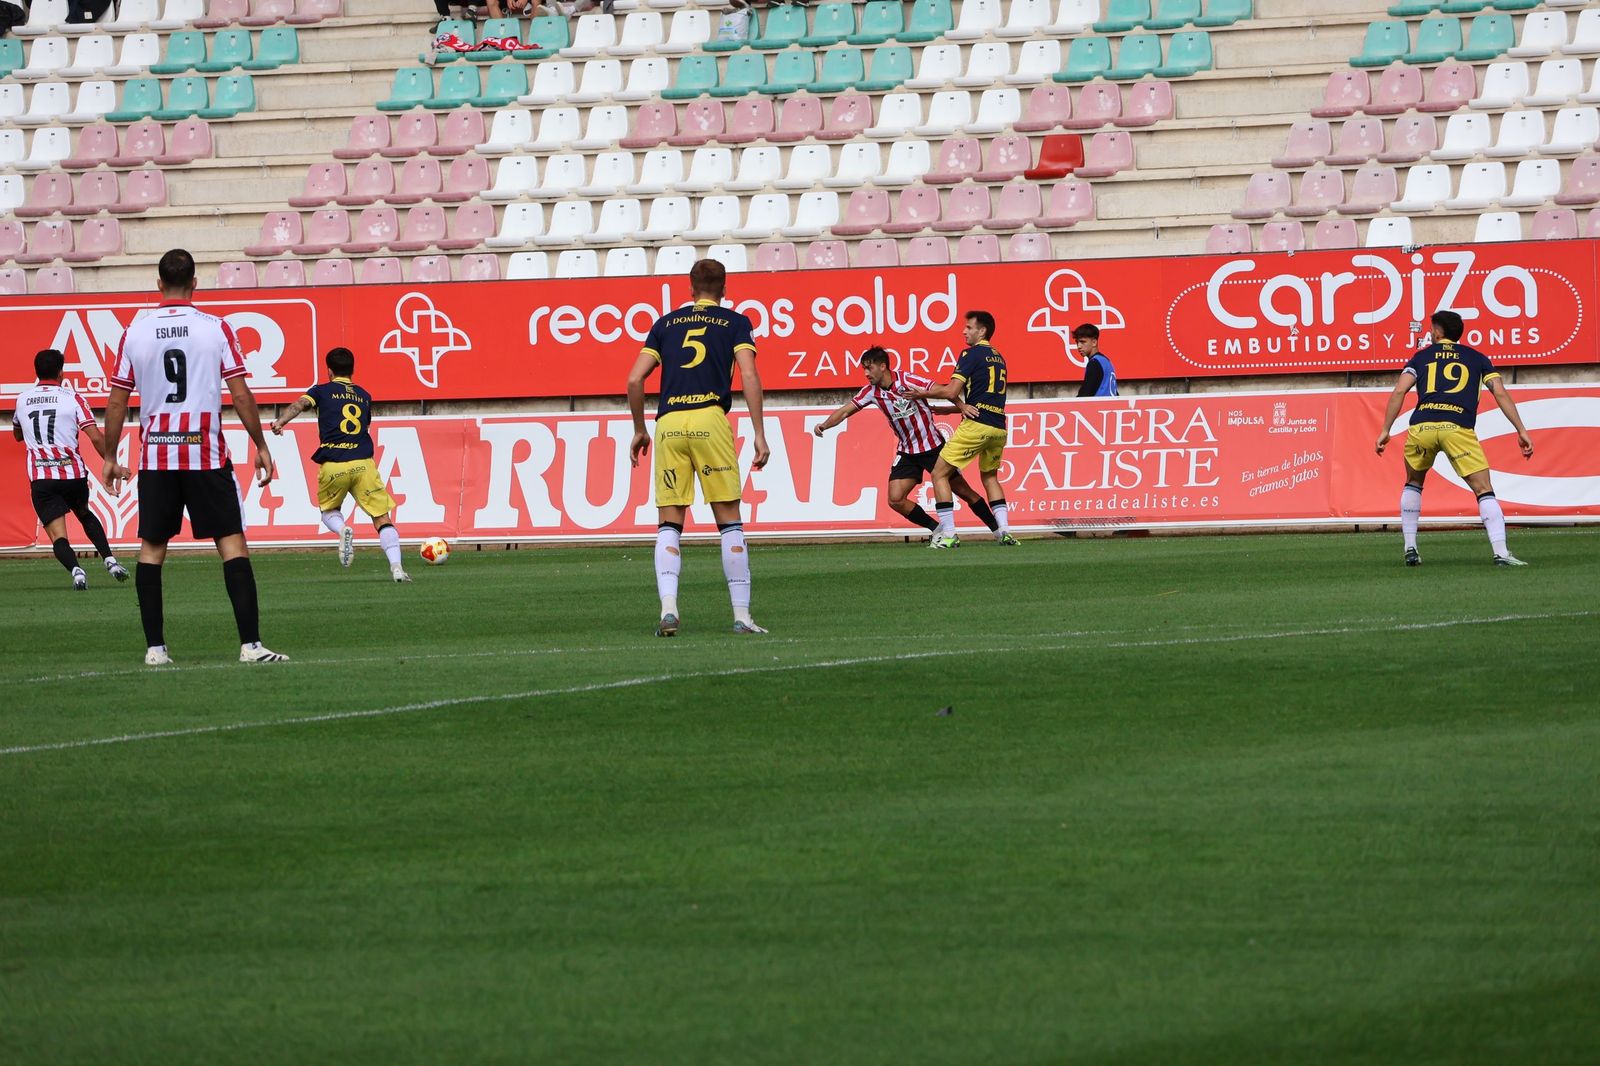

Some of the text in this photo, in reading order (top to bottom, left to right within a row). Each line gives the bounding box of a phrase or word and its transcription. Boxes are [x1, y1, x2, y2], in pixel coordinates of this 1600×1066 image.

[811, 273, 957, 335] salud
[156, 326, 189, 339] ESLAVA
[673, 313, 730, 328] DOMÍNGUEZ
[680, 326, 708, 369] 5
[1207, 327, 1540, 356] EMBUTIDOS Y JAONES
[1435, 351, 1460, 360] PIPE
[163, 349, 188, 404] 9
[986, 365, 1007, 395] 15
[1425, 361, 1470, 394] 19
[28, 409, 57, 445] 17
[339, 403, 362, 435] 8
[1004, 406, 1218, 449] ERNERA
[1268, 426, 1293, 434] Castilla
[147, 433, 203, 444] leomotor.net
[474, 418, 877, 529] RUAL
[1016, 447, 1220, 492] ALISTE
[1241, 449, 1324, 483] En tierra de lobos,
[1249, 467, 1319, 497] criamos jatos
